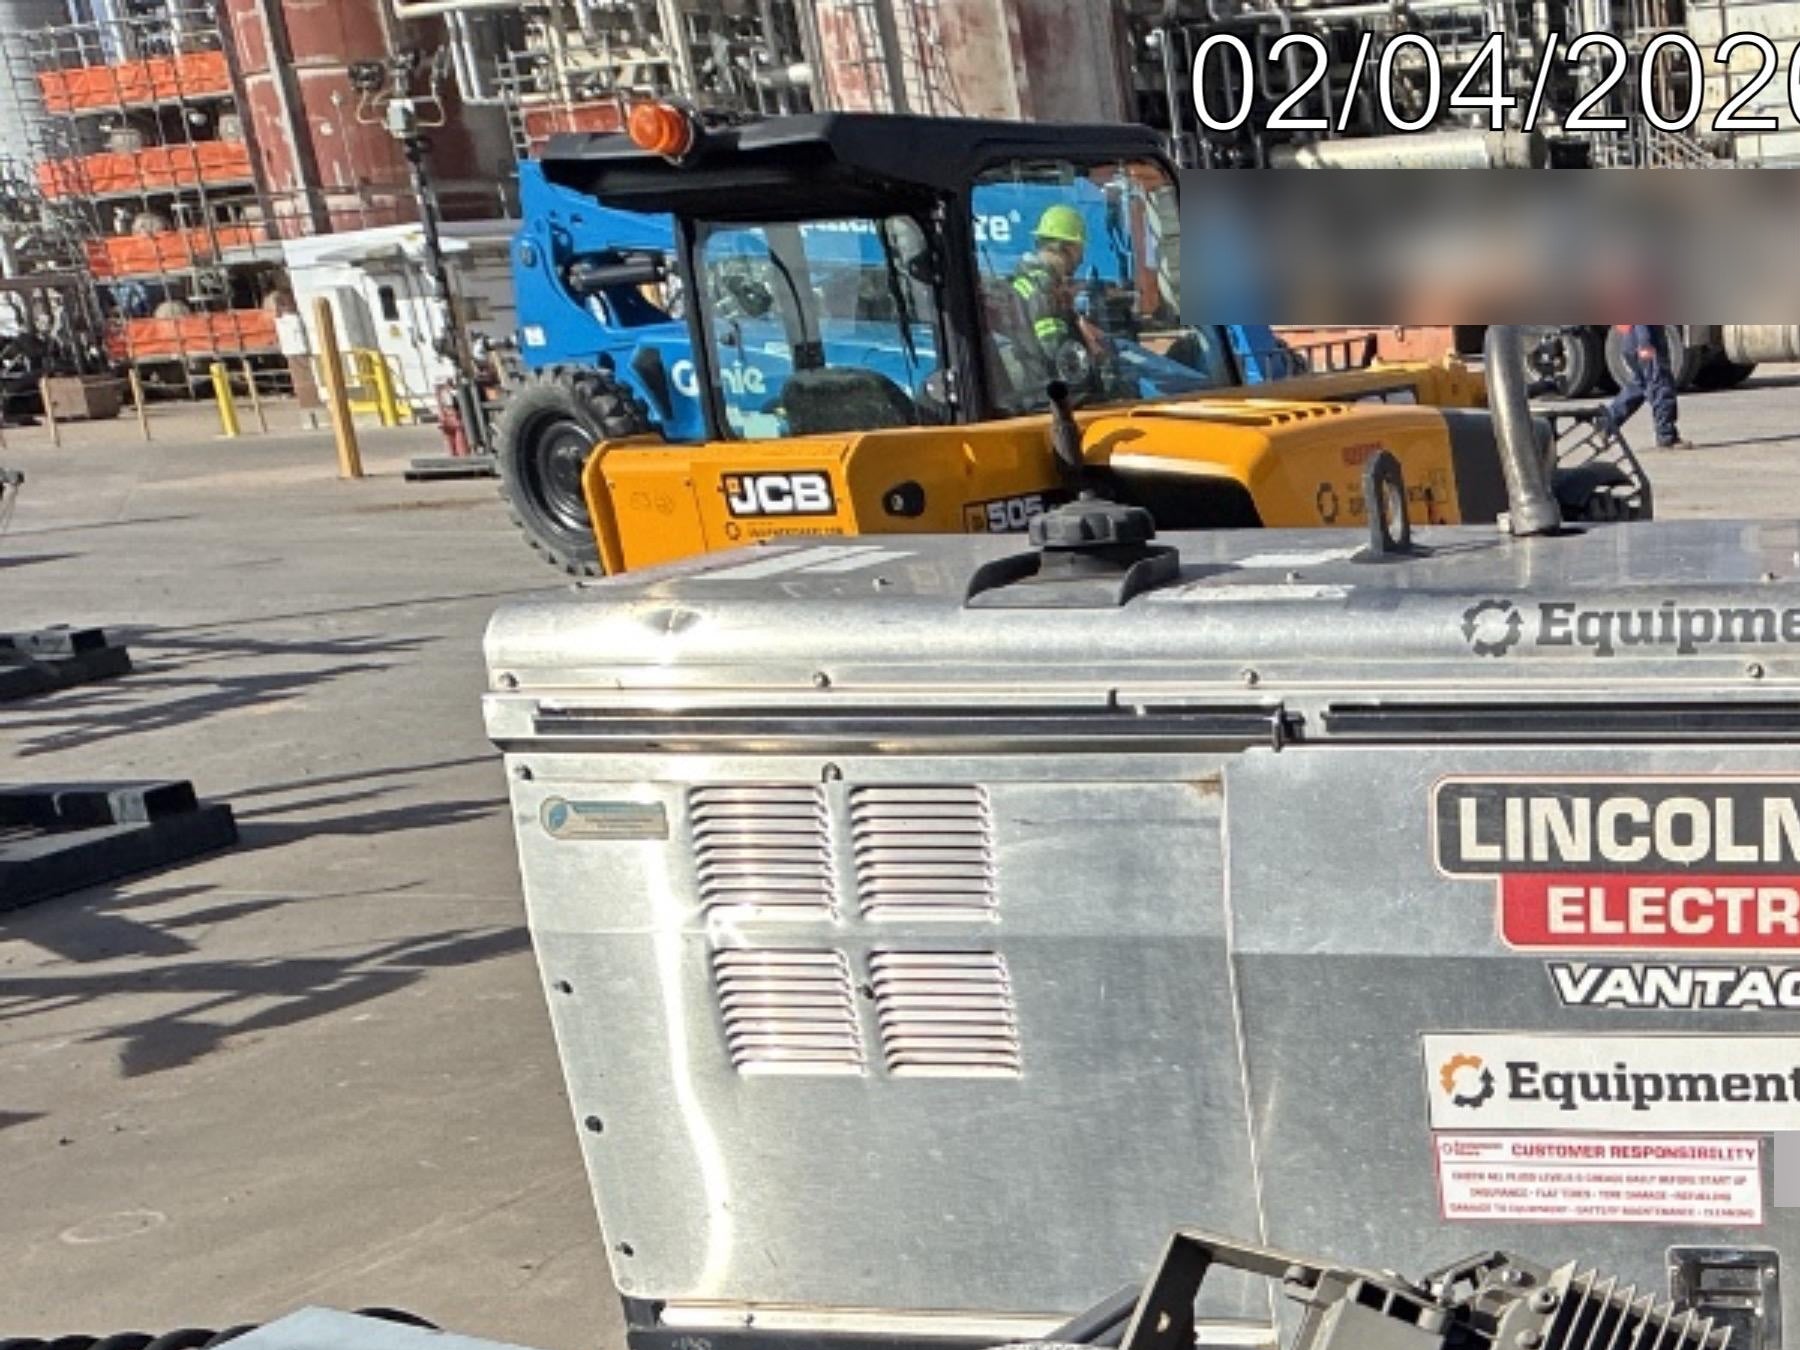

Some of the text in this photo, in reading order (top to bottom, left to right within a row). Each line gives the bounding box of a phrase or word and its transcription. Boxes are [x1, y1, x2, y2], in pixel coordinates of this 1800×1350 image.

[671, 359, 767, 397] Gnie
[728, 474, 832, 514] JCB
[1511, 1142, 1605, 1159] CUSTOMER
